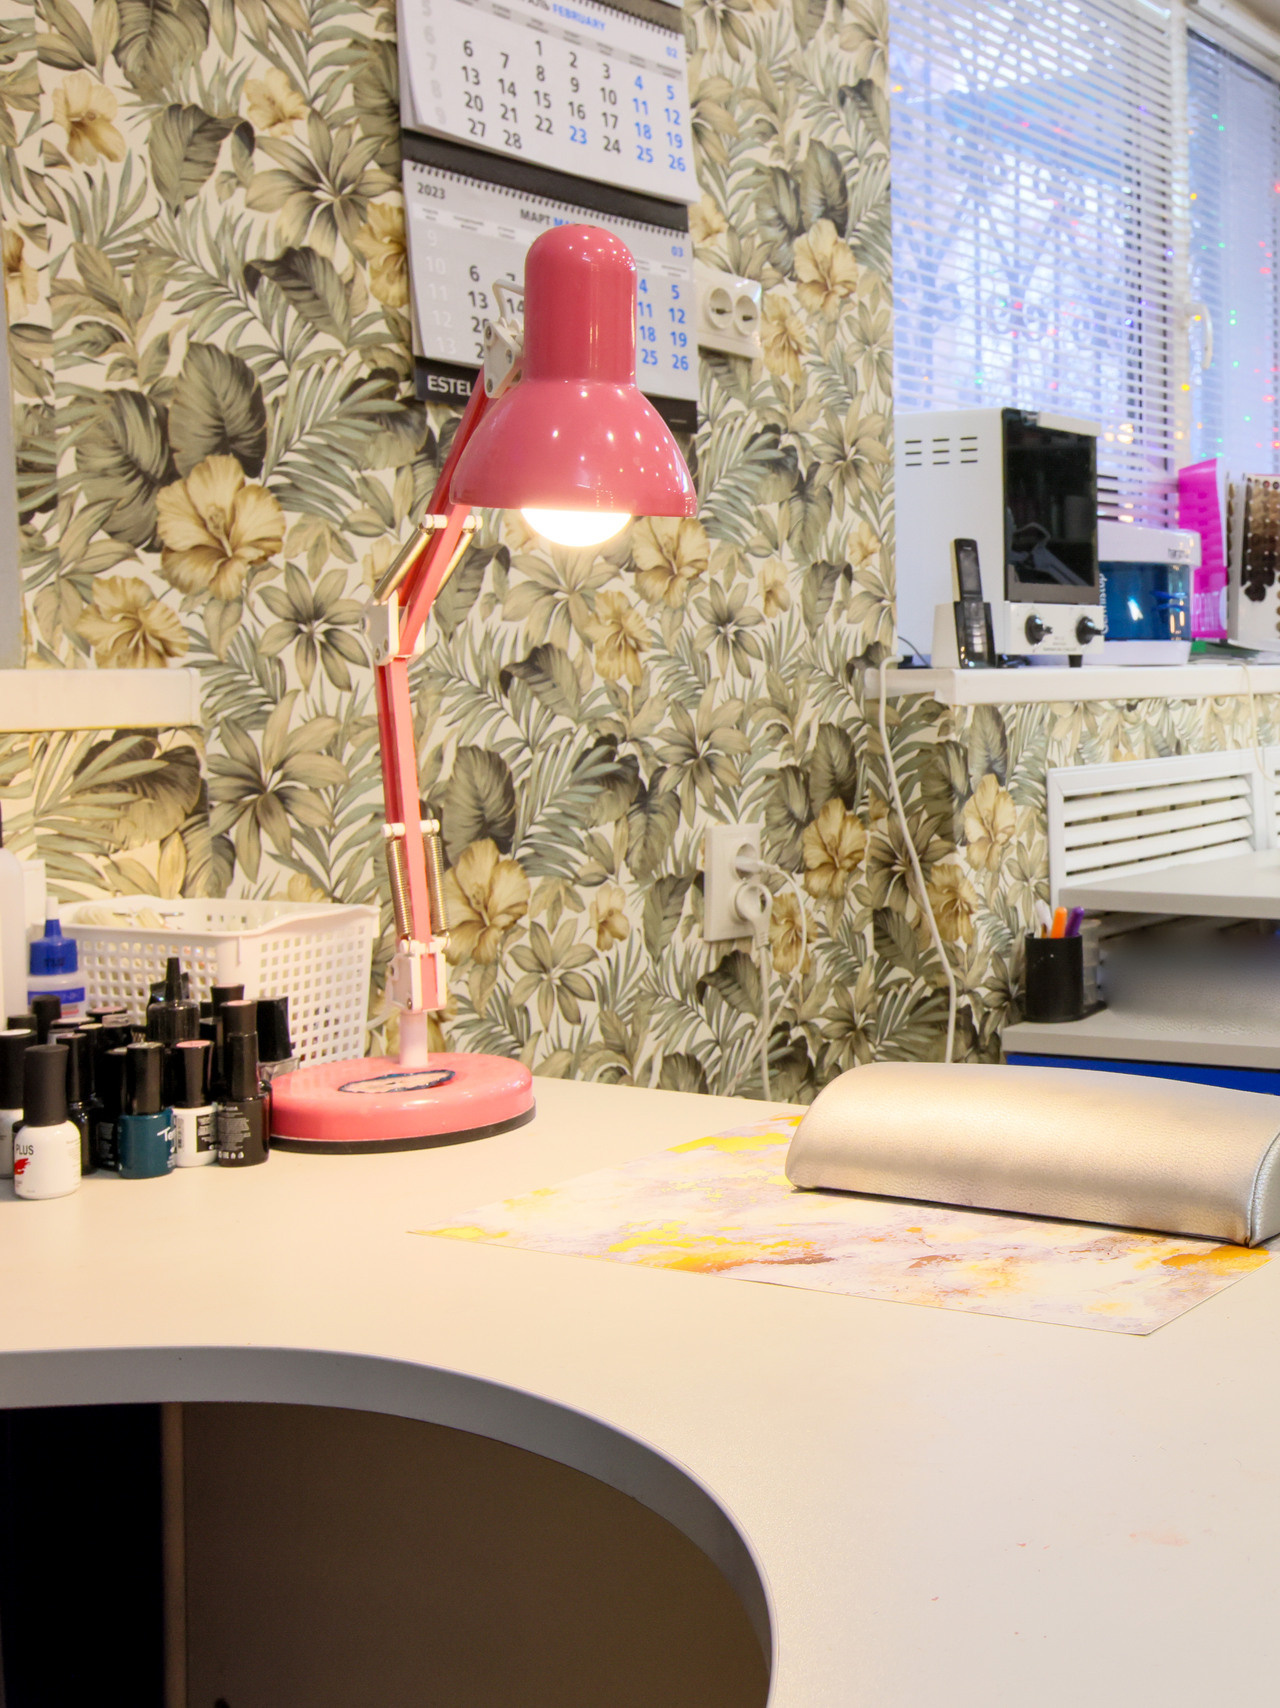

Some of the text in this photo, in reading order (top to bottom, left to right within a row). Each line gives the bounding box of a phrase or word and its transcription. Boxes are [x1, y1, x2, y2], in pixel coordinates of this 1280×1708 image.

[553, 3, 606, 31] FEBRUARY
[463, 40, 474, 57] 6
[500, 52, 510, 69] 7
[536, 65, 546, 82] 8
[570, 77, 580, 93] 9
[600, 87, 617, 106] 10
[632, 97, 649, 116] 11
[664, 107, 681, 126] 12
[534, 40, 543, 56] 1
[569, 51, 578, 69] 2
[602, 63, 611, 79] 3
[634, 75, 644, 90] 4
[666, 85, 676, 100] 5
[461, 65, 480, 86] 13
[498, 78, 517, 98] 14
[534, 89, 551, 109] 15
[568, 101, 586, 120] 16
[601, 112, 618, 130] 17
[634, 122, 652, 140] 18
[666, 131, 683, 149] 19
[464, 91, 483, 113] 20
[500, 103, 517, 124] 21
[535, 114, 554, 135] 22
[569, 125, 588, 145] 23
[602, 135, 621, 155] 24
[636, 144, 654, 164] 25
[668, 153, 686, 172] 26
[467, 117, 486, 138] 27
[503, 128, 522, 149] 28
[417, 182, 446, 200] 2023
[520, 208, 551, 226] МАРТ
[469, 265, 480, 282] 6
[637, 301, 653, 319] 11
[668, 308, 686, 325] 12
[639, 278, 649, 294] 4
[671, 284, 680, 300] 5
[468, 291, 488, 309] 13
[639, 325, 656, 343] 18
[670, 331, 688, 349] 19
[641, 349, 659, 366] 25
[671, 354, 689, 372] 26
[427, 375, 472, 396] ESTEL
[15, 1143, 34, 1156] PLUS
